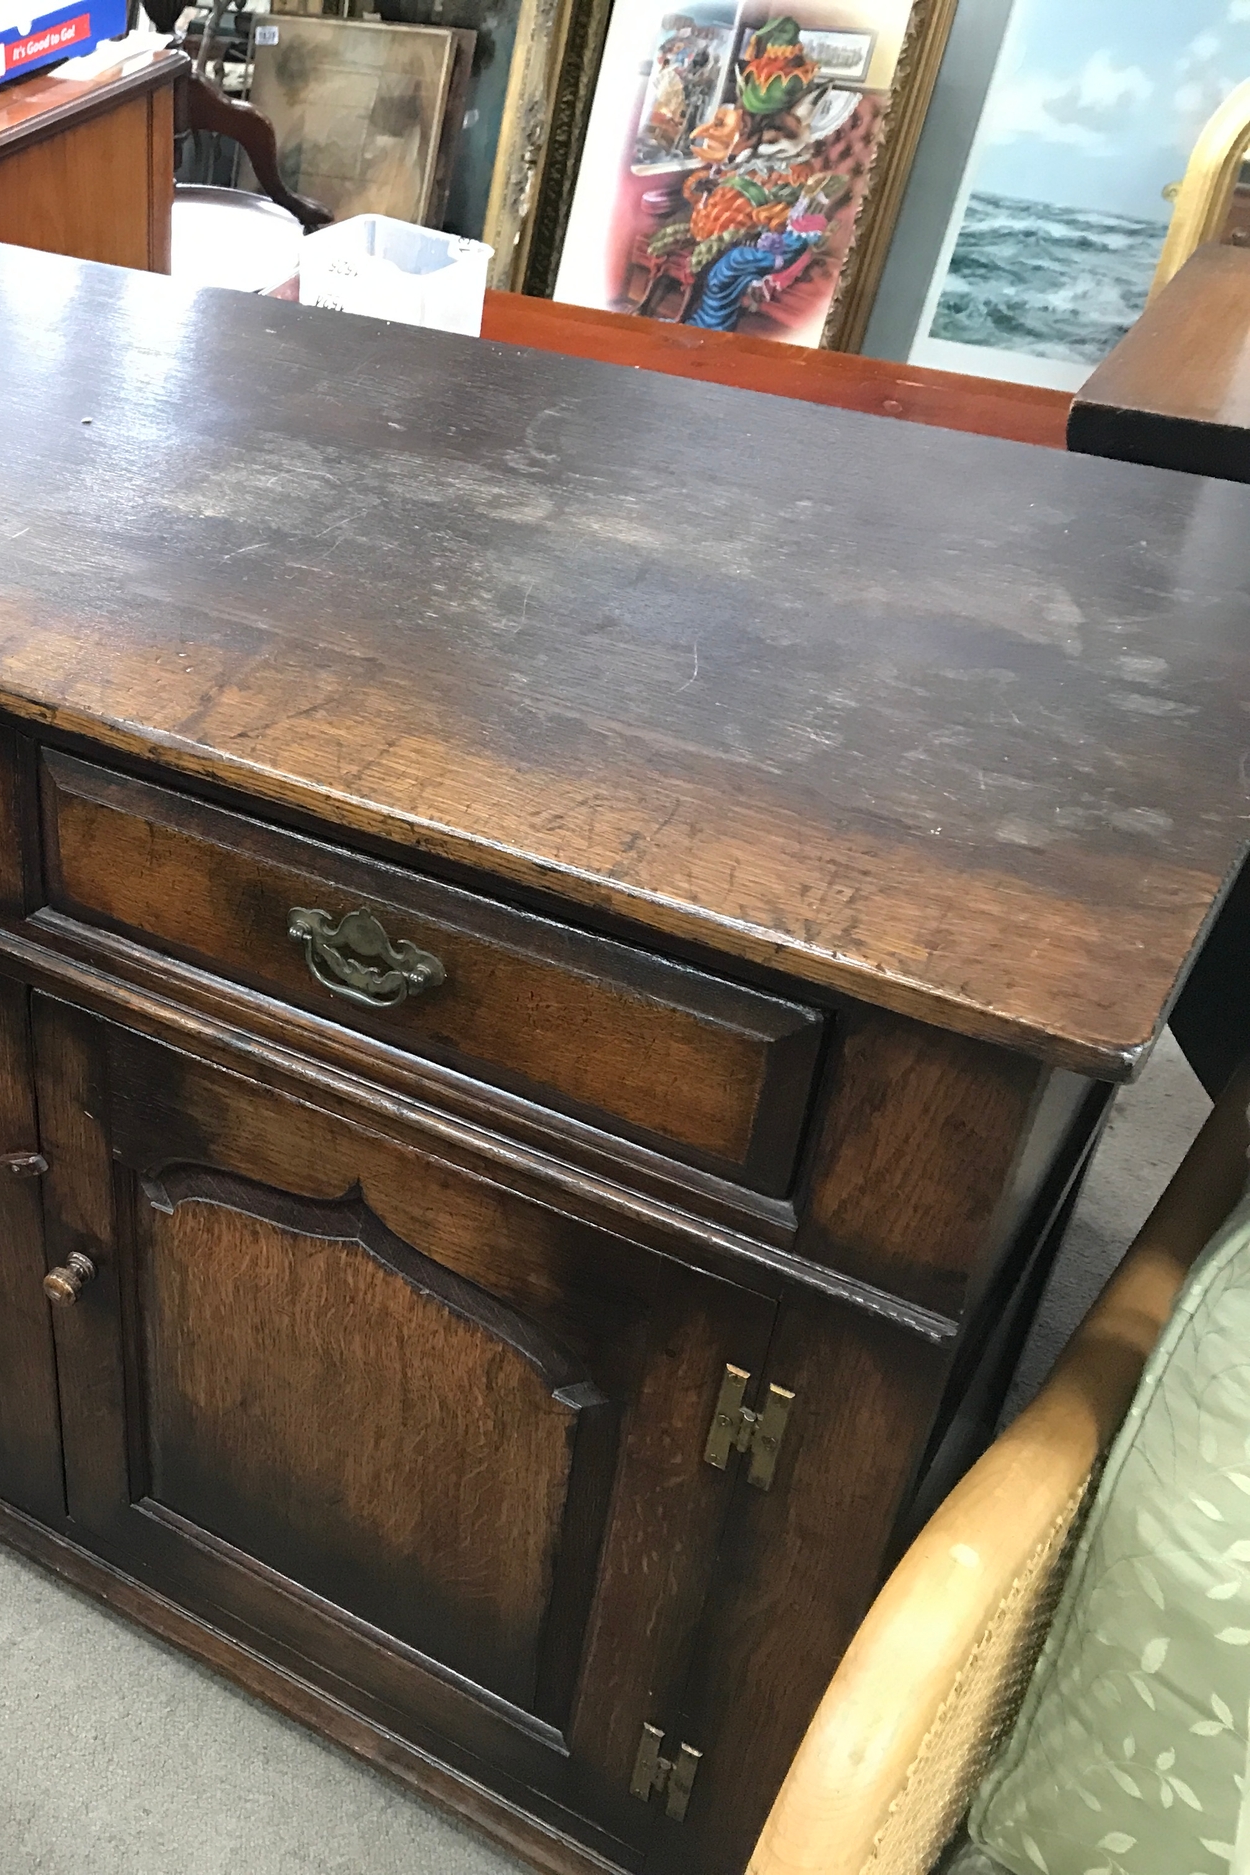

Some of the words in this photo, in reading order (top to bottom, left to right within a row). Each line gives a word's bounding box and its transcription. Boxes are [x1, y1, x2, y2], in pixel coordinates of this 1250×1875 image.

[12, 46, 26, 61] It's
[27, 34, 50, 55] Good
[50, 33, 60, 45] to
[60, 24, 76, 41] Go!
